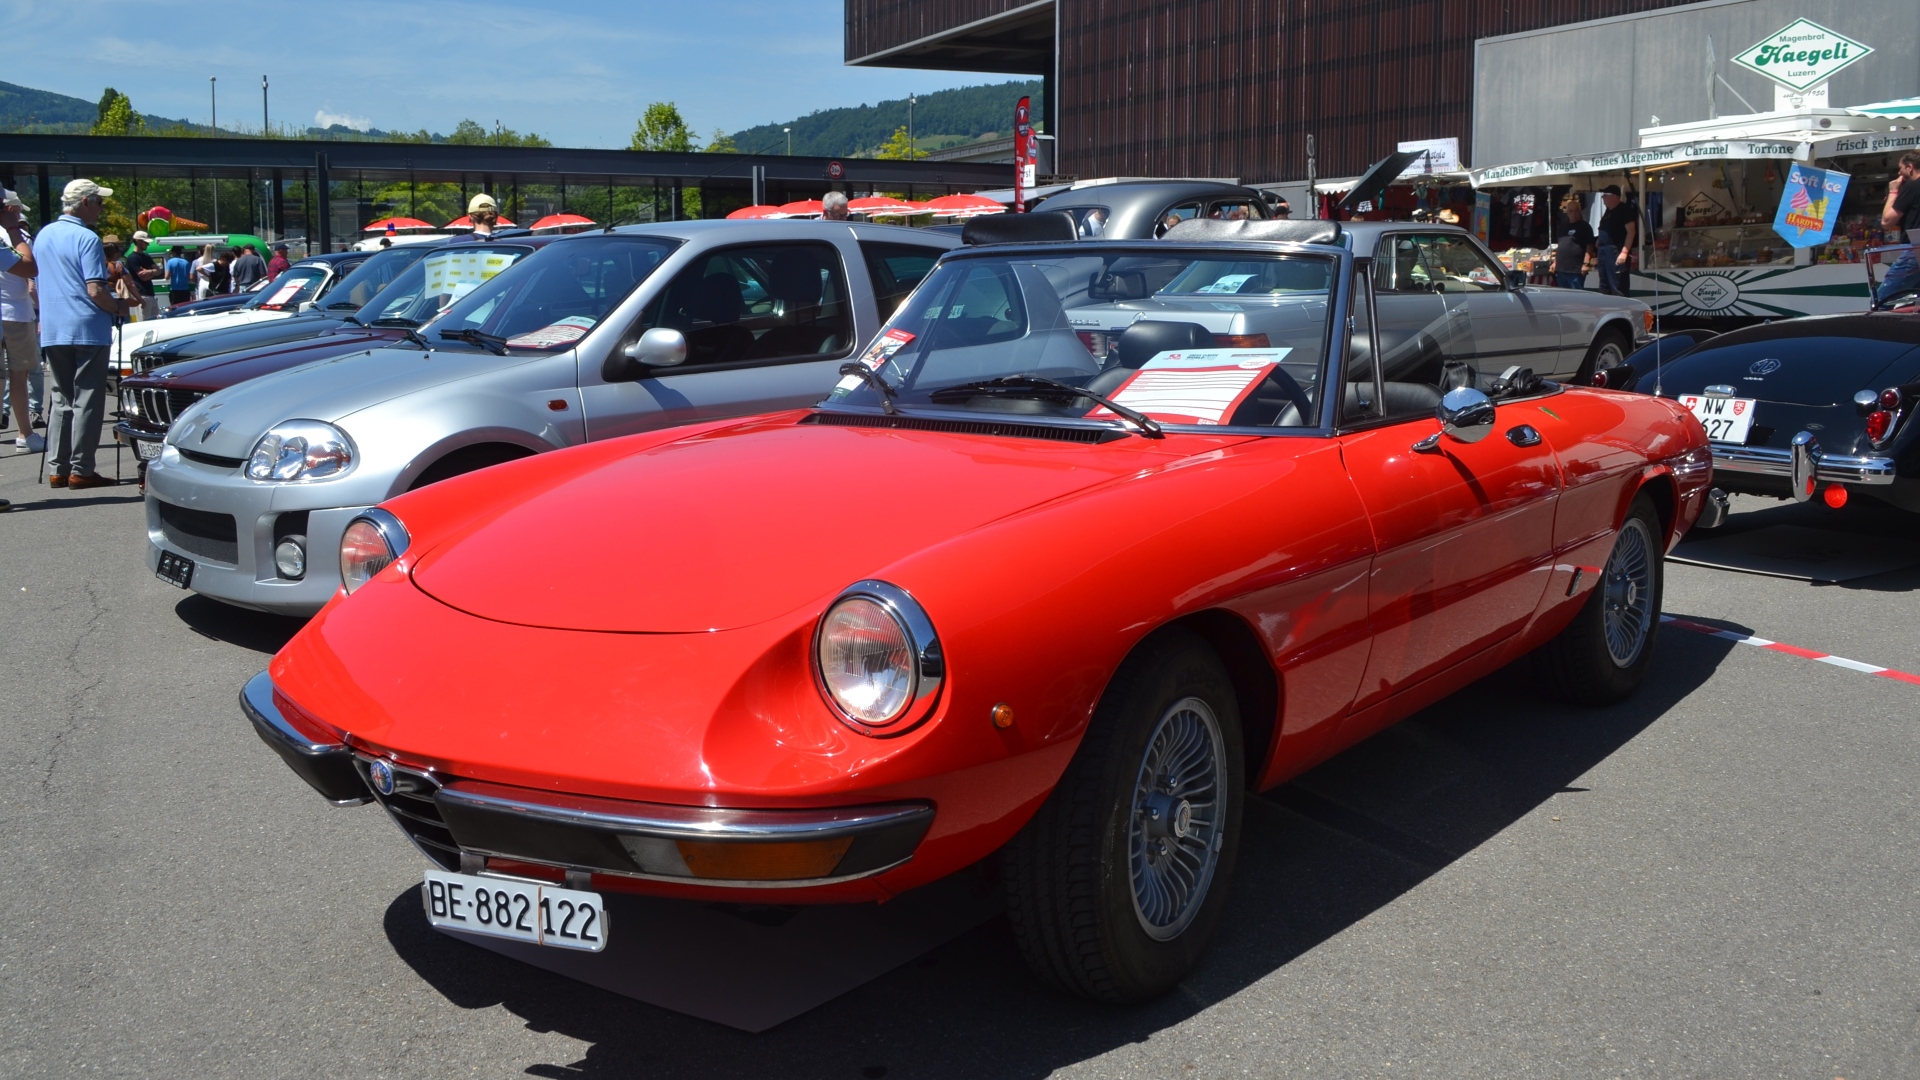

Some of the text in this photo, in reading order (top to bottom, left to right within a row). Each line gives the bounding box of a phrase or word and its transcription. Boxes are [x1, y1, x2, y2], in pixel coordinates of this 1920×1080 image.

[1779, 33, 1825, 43] Magenbrot
[1754, 42, 1849, 67] Haegeli
[1787, 69, 1817, 77] Luzern
[1836, 138, 1868, 152] frisch
[1483, 143, 1794, 179] MandelBiber Nougat feines Magenbrot Caramel Torrone
[1790, 171, 1842, 193] Soft Ice
[1698, 287, 1722, 296] Haegeli
[1703, 399, 1726, 415] NW
[540, 897, 599, 942] 122
